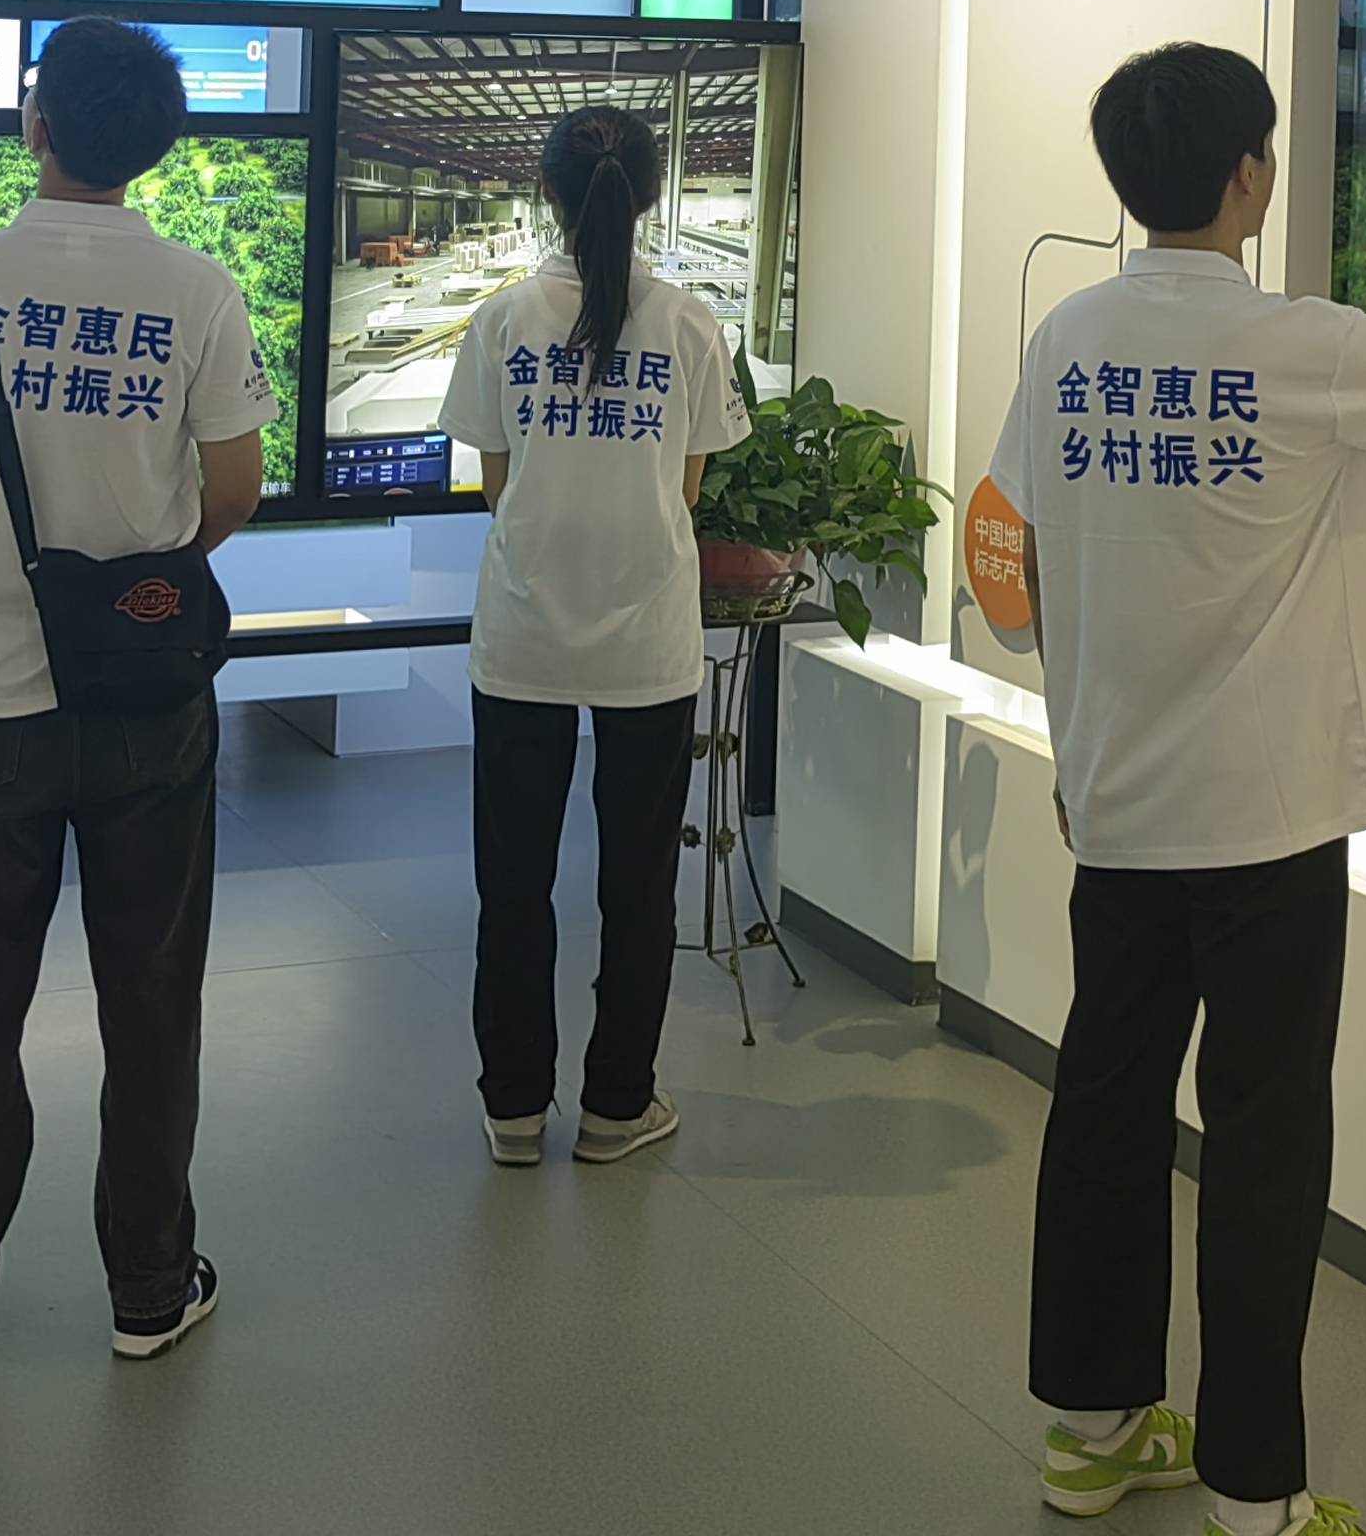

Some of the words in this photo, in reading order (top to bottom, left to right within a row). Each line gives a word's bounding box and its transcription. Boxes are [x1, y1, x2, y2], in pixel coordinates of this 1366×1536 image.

[1055, 360, 1261, 424] 金智惠民
[1061, 426, 1266, 488] 乡村振兴
